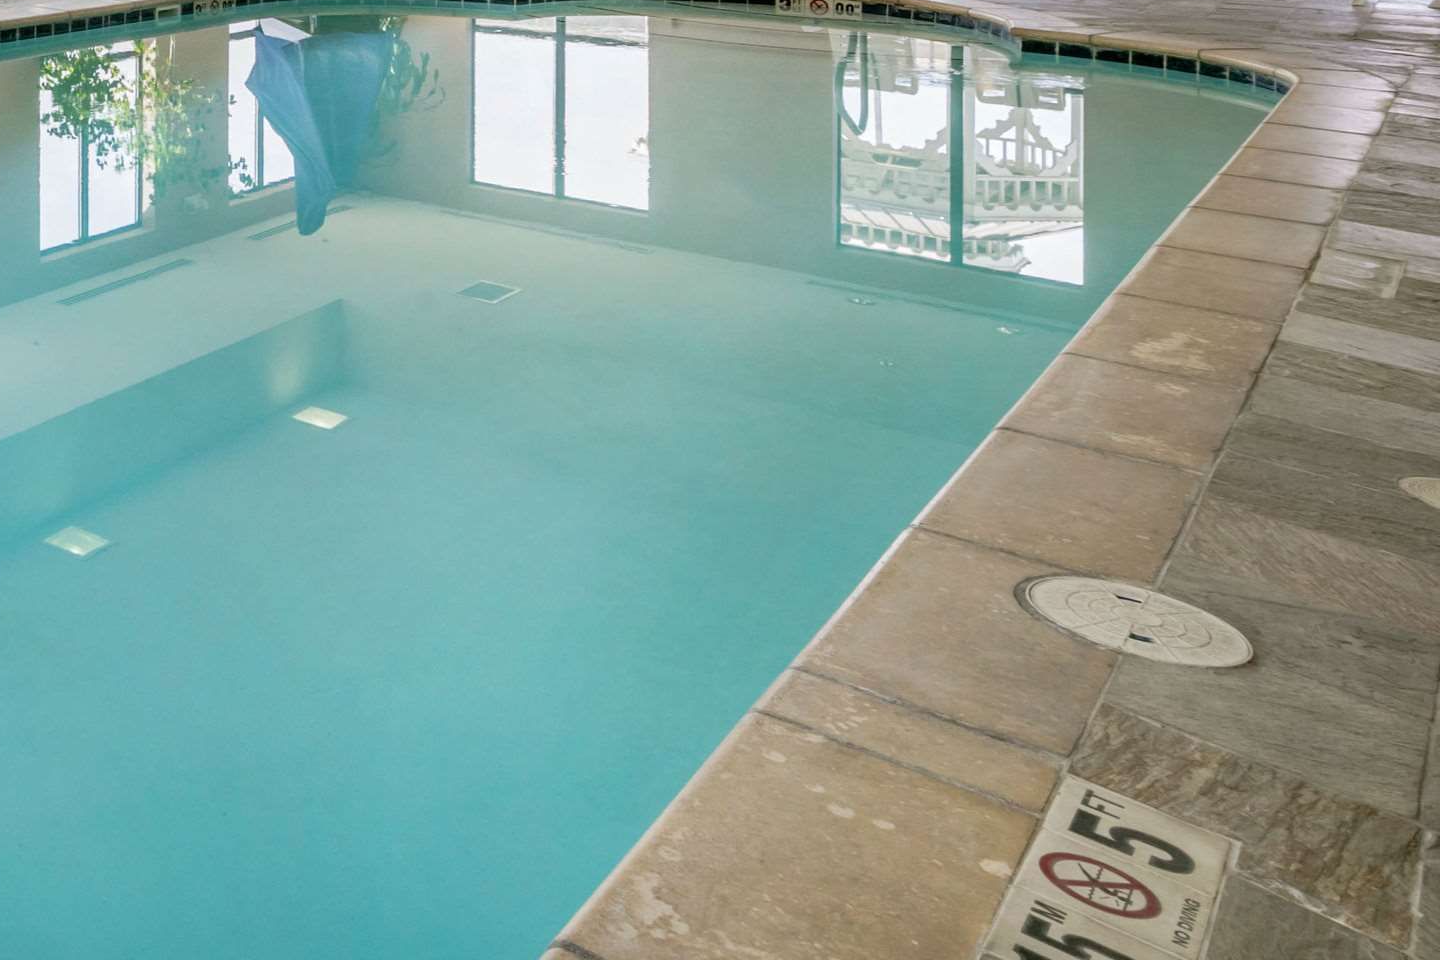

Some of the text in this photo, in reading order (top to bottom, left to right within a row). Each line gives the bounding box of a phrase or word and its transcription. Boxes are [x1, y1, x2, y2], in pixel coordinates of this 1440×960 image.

[1068, 789, 1196, 874] 5 FT
[1030, 899, 1068, 925] M
[1171, 897, 1201, 948] NO DIVING
